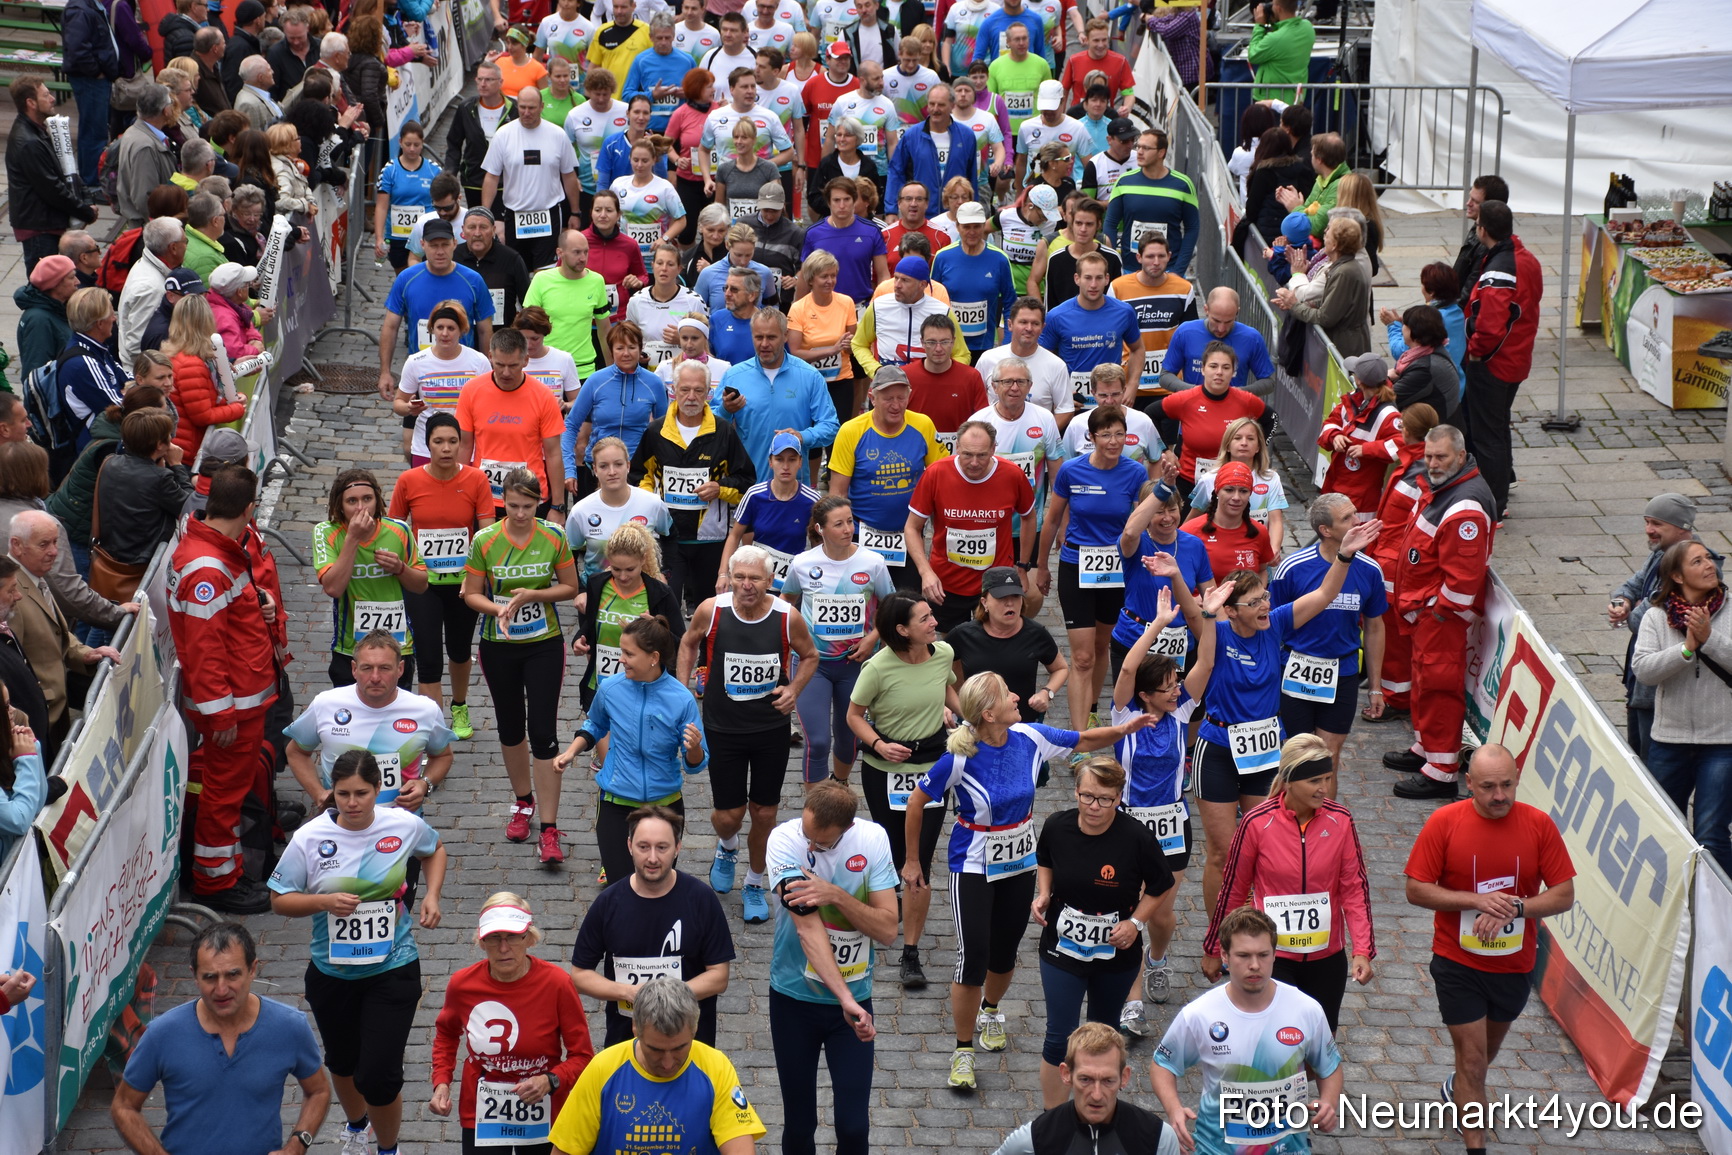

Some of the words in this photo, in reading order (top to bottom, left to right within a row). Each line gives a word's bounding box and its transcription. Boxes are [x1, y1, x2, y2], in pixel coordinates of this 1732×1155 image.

[1007, 97, 1031, 109] 2341
[518, 212, 548, 226] 2080
[630, 230, 660, 244] 2283
[1005, 245, 1037, 256] Lauftea
[260, 275, 273, 300] BMW
[267, 231, 282, 275] Laufsport
[954, 310, 985, 324] 3029
[1136, 310, 1174, 320] Fischer
[447, 377, 458, 387] BEI
[543, 377, 556, 387] MIR
[1144, 376, 1159, 384] David
[497, 462, 520, 471] Neumarkt
[672, 495, 699, 505] Raimund
[944, 508, 998, 519] NEUMARKT
[437, 531, 461, 539] Neumarkt
[948, 530, 964, 539] PARTL
[965, 531, 989, 539] Neumarkt
[863, 531, 903, 550] 2202
[423, 538, 465, 557] 2772
[956, 539, 987, 555] 299
[433, 559, 457, 568] Sandra
[959, 556, 983, 565] Werner
[1084, 554, 1121, 572] 2297
[492, 561, 550, 579] BOCK
[814, 597, 833, 605] PARTL
[834, 597, 857, 605] Neumarkt
[513, 601, 542, 623] 753
[818, 605, 861, 623] 2339
[359, 612, 403, 630] 2747
[511, 623, 535, 634] Annika
[825, 625, 852, 635] Daniela
[1148, 636, 1185, 655] 2288
[597, 648, 613, 657] PARTL
[726, 656, 744, 664] PARTL
[745, 657, 772, 665] Neumarkt
[1291, 652, 1307, 661] PARTL
[1307, 657, 1331, 667] Neumarkt
[729, 664, 776, 684] 2684
[1289, 661, 1334, 685] 2469
[1300, 685, 1316, 695] Uwe
[331, 726, 350, 734] PARTL
[1229, 725, 1249, 735] PARTL
[1250, 723, 1272, 733] Neumarkt
[1236, 729, 1278, 755] 3100
[1148, 808, 1175, 817] Neumarkt
[988, 833, 1009, 841] PARTL
[1009, 828, 1031, 840] Neumarkt
[992, 833, 1033, 862] 2148
[319, 859, 339, 868] PARTL
[1003, 860, 1025, 871] Conny
[1487, 880, 1505, 890] DEHN
[1266, 899, 1287, 908] PARTL
[1289, 898, 1319, 907] Neumarkt
[352, 907, 384, 916] Neumarkt
[1079, 915, 1111, 925] Neumarkt
[1280, 907, 1320, 932] 178
[335, 915, 390, 941] 2813
[837, 933, 864, 944] Neumarkt
[1289, 935, 1312, 947] Birgit
[1481, 939, 1507, 949] Mario
[351, 945, 374, 956] Julia
[615, 961, 635, 970] PARTL
[636, 962, 670, 971] Neumarkt
[479, 1086, 502, 1096] PARTL
[1222, 1086, 1246, 1095] PARTL
[1247, 1086, 1283, 1095] Neumarkt
[483, 1097, 545, 1122] 2485
[500, 1126, 526, 1137] Heidi
[1244, 1125, 1277, 1137] Tobias
[625, 1143, 665, 1151] 21.September
